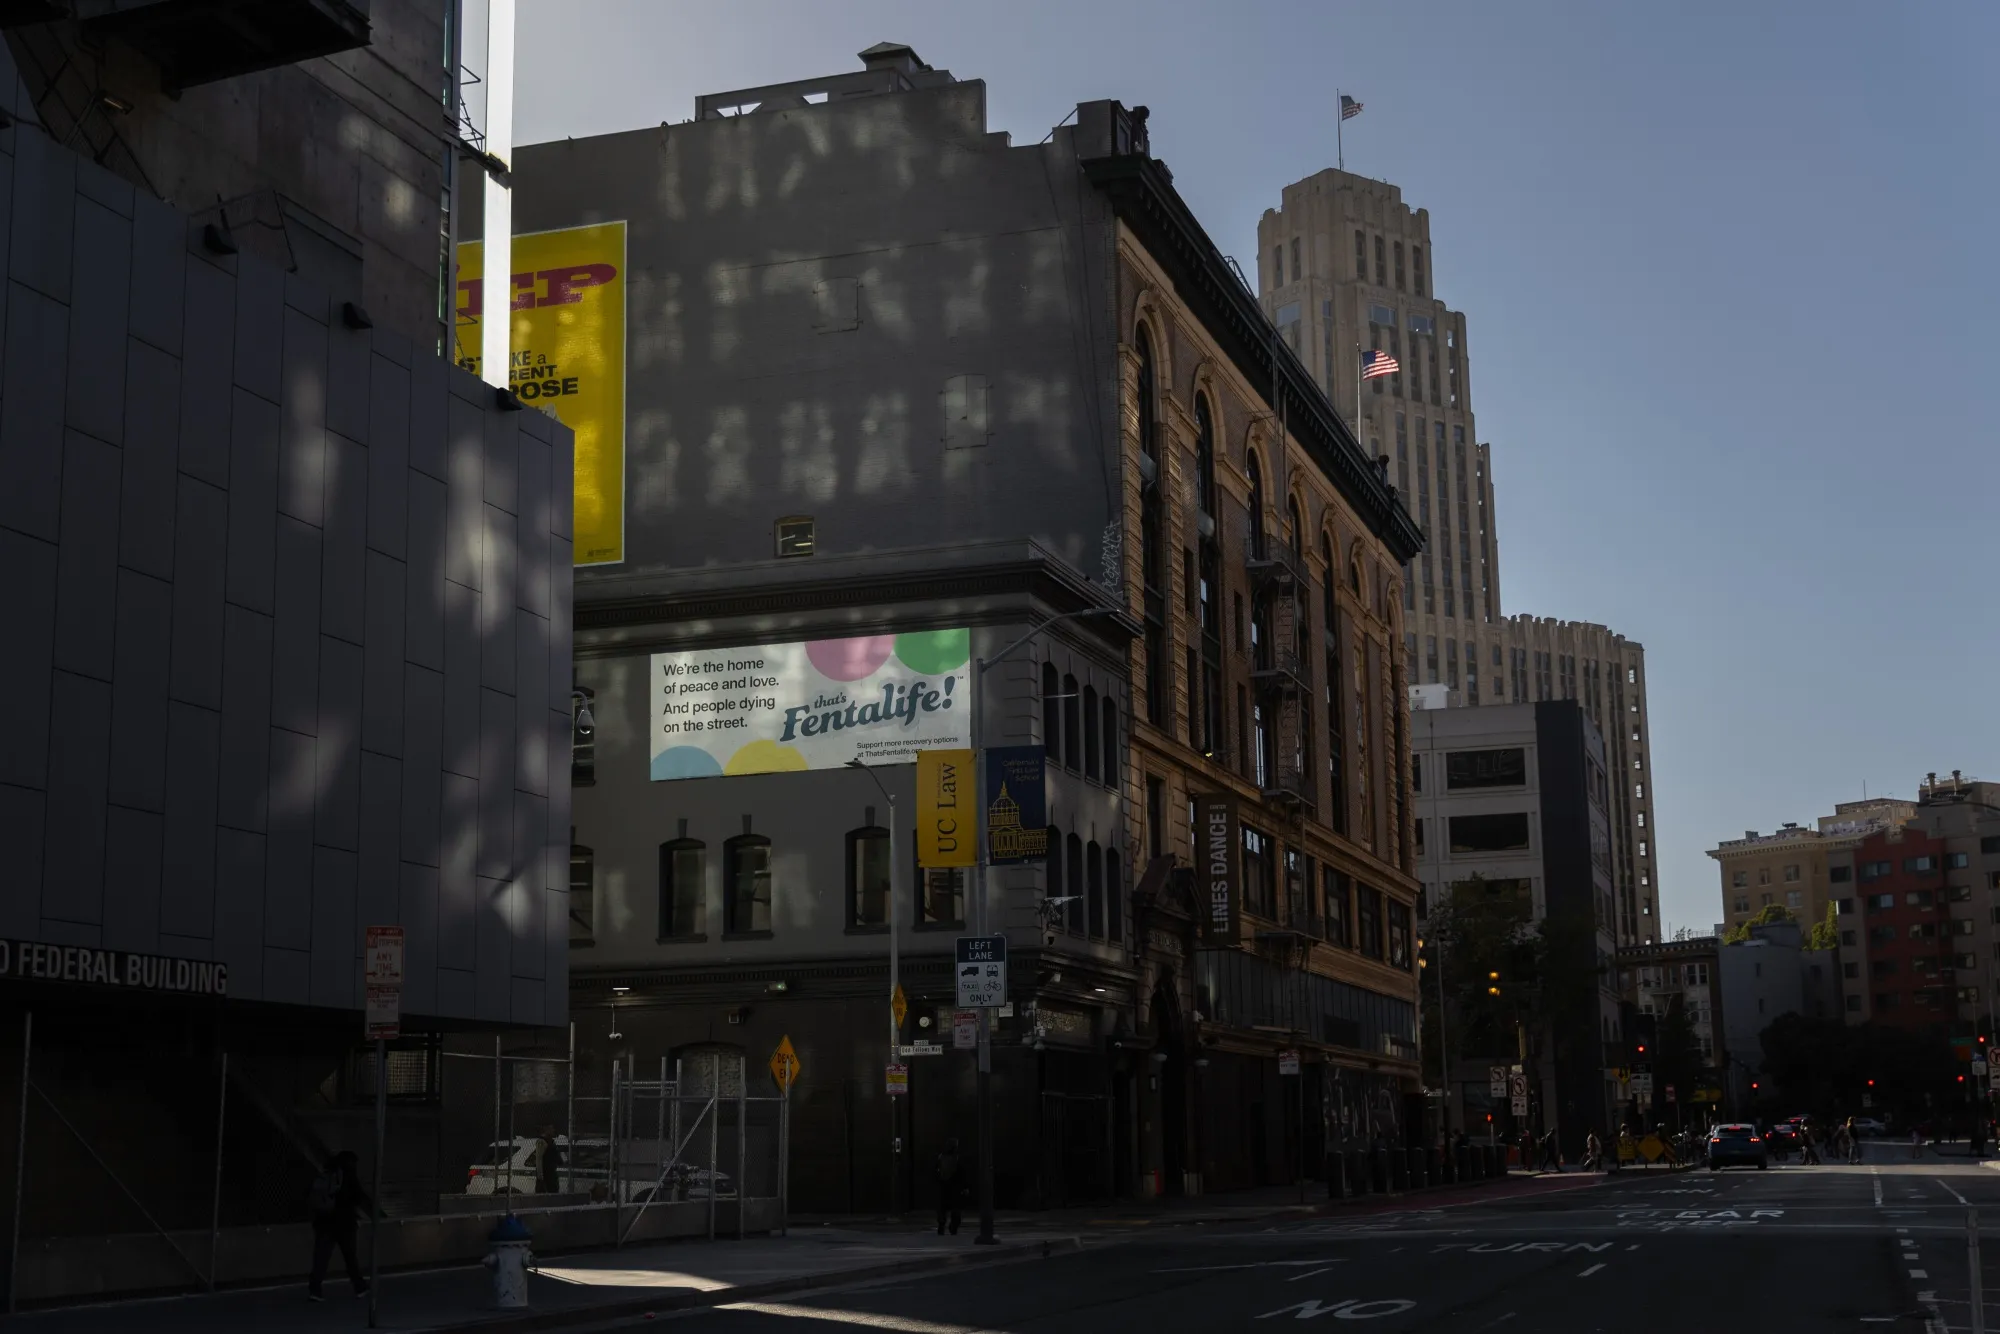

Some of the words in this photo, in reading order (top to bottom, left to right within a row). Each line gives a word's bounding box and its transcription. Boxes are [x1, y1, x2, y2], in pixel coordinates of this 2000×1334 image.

[511, 350, 532, 367] KE
[537, 353, 547, 365] a
[509, 365, 558, 382] RENT
[663, 663, 700, 677] We're
[703, 661, 724, 673] the
[727, 659, 764, 671] home
[664, 682, 676, 694] of
[680, 681, 719, 696] peace
[722, 676, 746, 690] and
[750, 675, 779, 688] love.
[663, 702, 689, 715] And
[692, 699, 736, 715] people
[739, 696, 775, 711] dying
[779, 675, 956, 742] Fentalife!
[814, 691, 847, 709] that's
[664, 723, 679, 733] on
[683, 719, 704, 732] the
[707, 716, 748, 730] street.
[856, 742, 884, 750] Support
[885, 739, 902, 747] more
[902, 738, 932, 747] recovery
[933, 736, 959, 745] options
[937, 762, 957, 810] Law
[937, 818, 957, 855] UC
[1209, 812, 1228, 875] DANCE
[1211, 880, 1229, 933] LINES
[969, 941, 992, 950] LEFT
[376, 952, 393, 961] ANY
[968, 951, 993, 960] LANE
[17, 941, 120, 985] FEDERAL
[126, 954, 227, 995] BUILDING
[375, 963, 393, 972] TIME
[969, 994, 993, 1002] ONLY
[1616, 1210, 1785, 1219] CLEAR
[1427, 1241, 1616, 1254] TURN
[1254, 1298, 1418, 1319] NO
